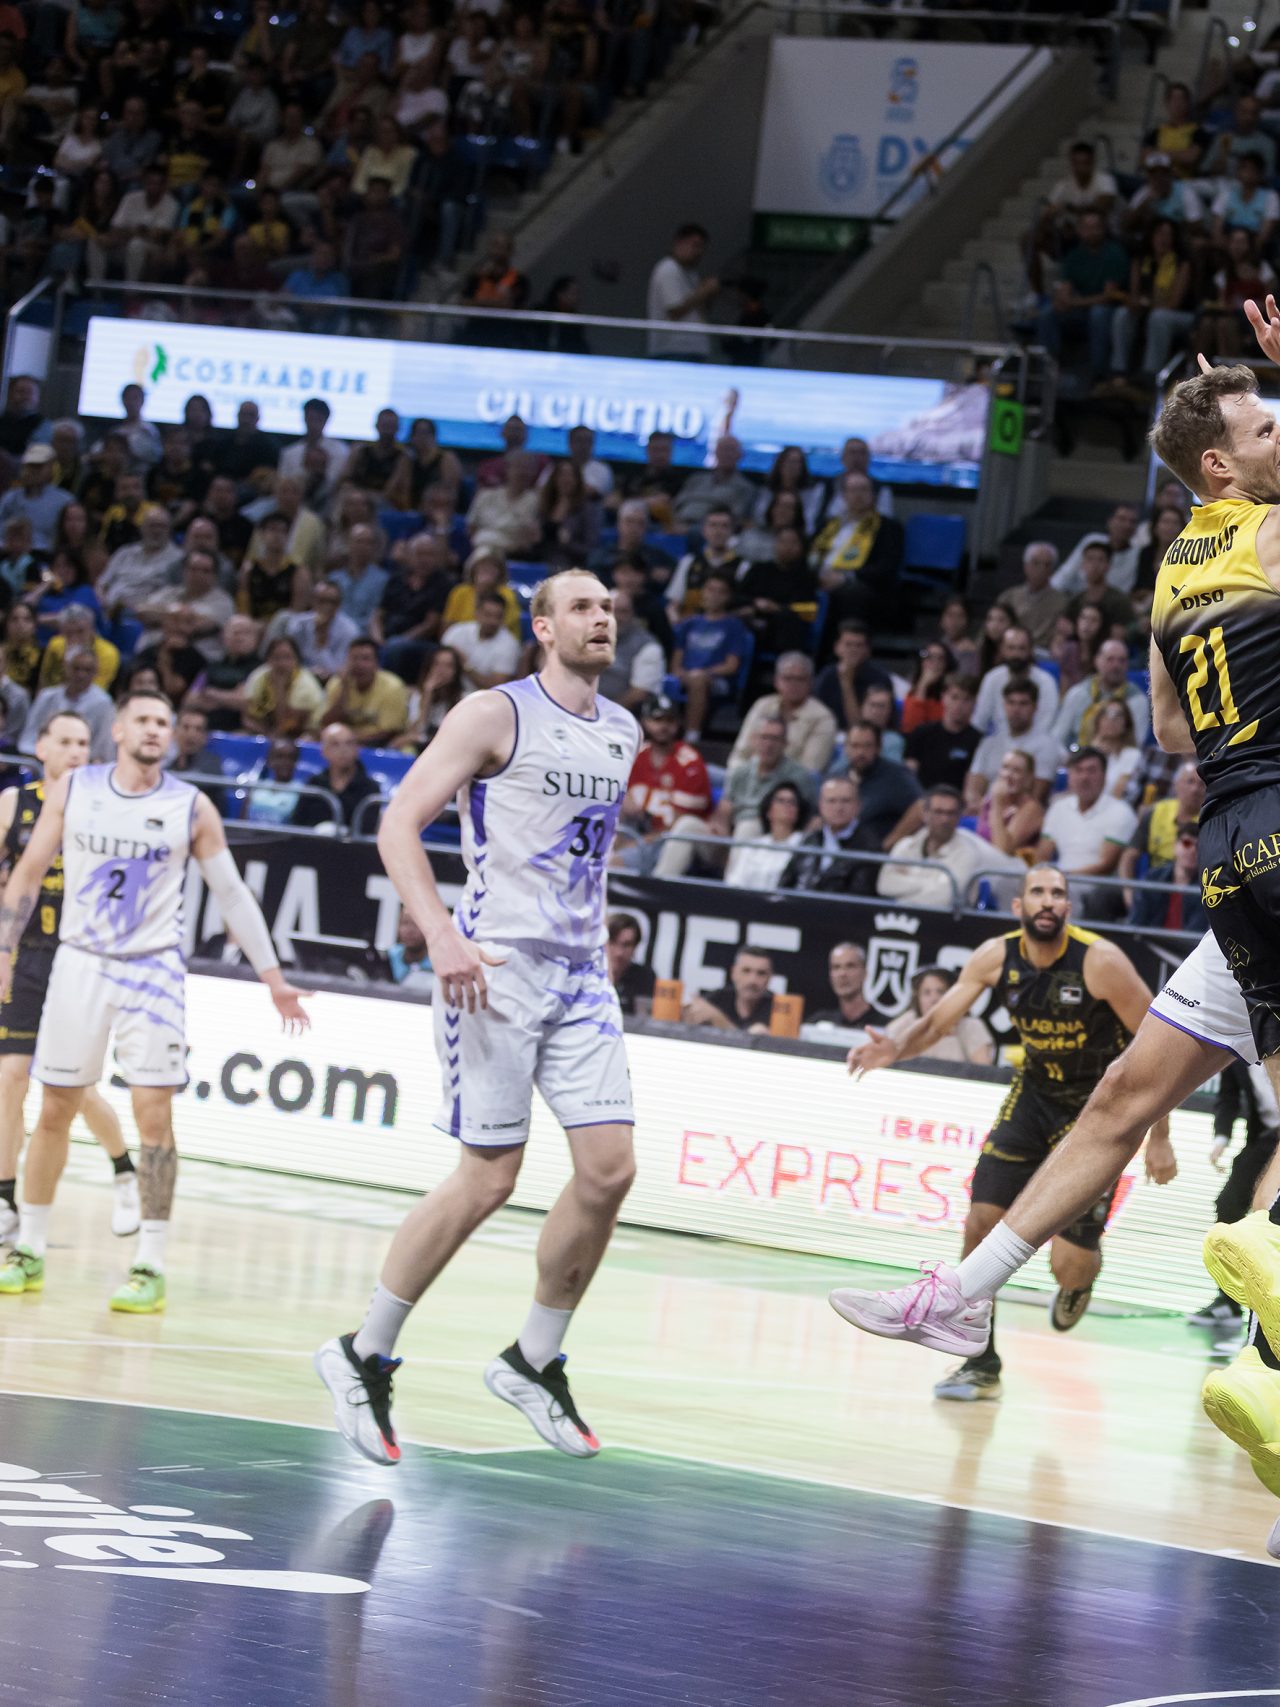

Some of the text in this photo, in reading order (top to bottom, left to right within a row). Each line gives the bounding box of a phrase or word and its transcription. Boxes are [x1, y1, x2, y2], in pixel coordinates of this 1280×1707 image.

[1180, 626, 1241, 732] 21
[542, 769, 625, 804] surn
[74, 833, 172, 862] surne
[567, 816, 607, 860] 32
[107, 869, 128, 900] 2
[1250, 860, 1278, 878] Islands
[1165, 987, 1196, 1008] CORREO
[176, 1046, 398, 1128] .com
[679, 1130, 974, 1227] EXPRES
